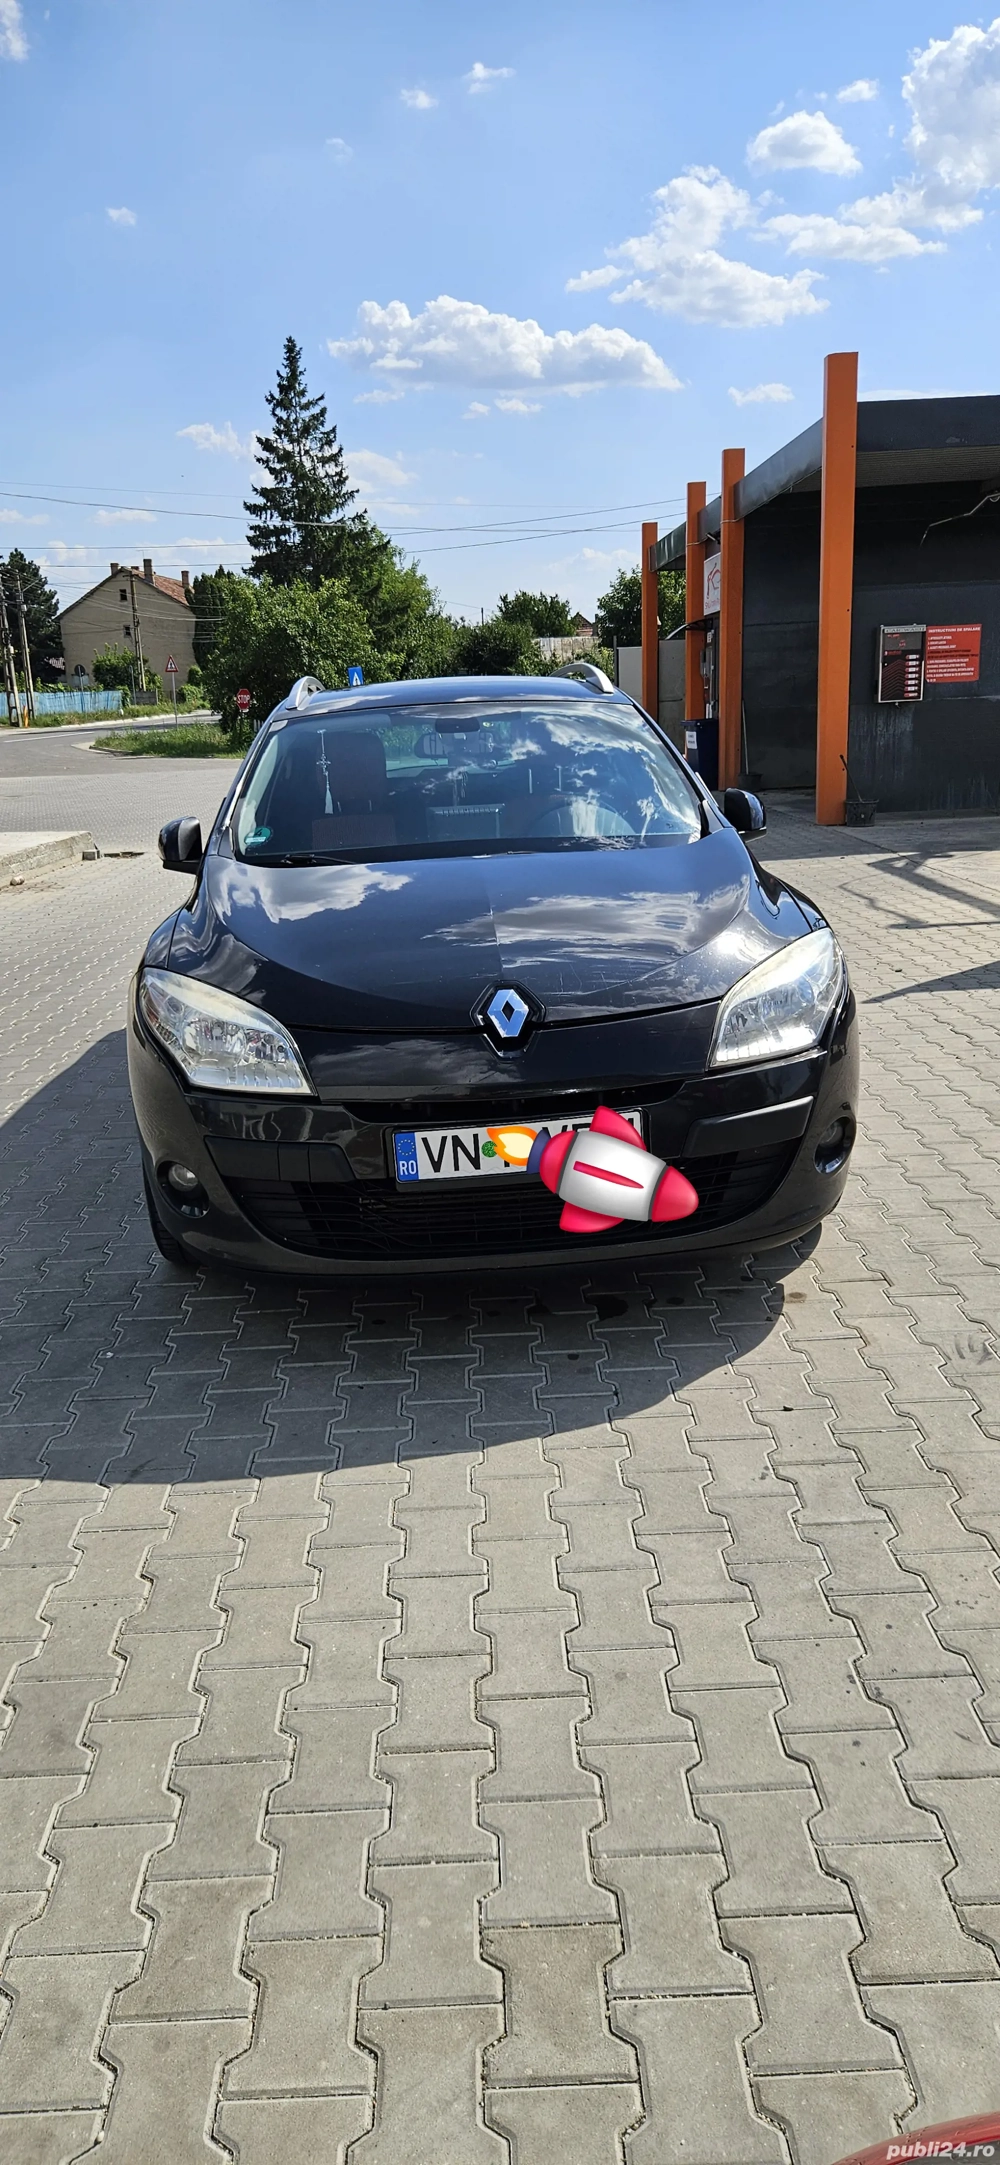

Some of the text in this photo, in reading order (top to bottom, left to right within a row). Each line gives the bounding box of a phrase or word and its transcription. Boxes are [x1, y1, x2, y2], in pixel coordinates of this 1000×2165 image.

[237, 695, 250, 704] STOP
[421, 1133, 481, 1173] VN
[399, 1160, 417, 1176] RO
